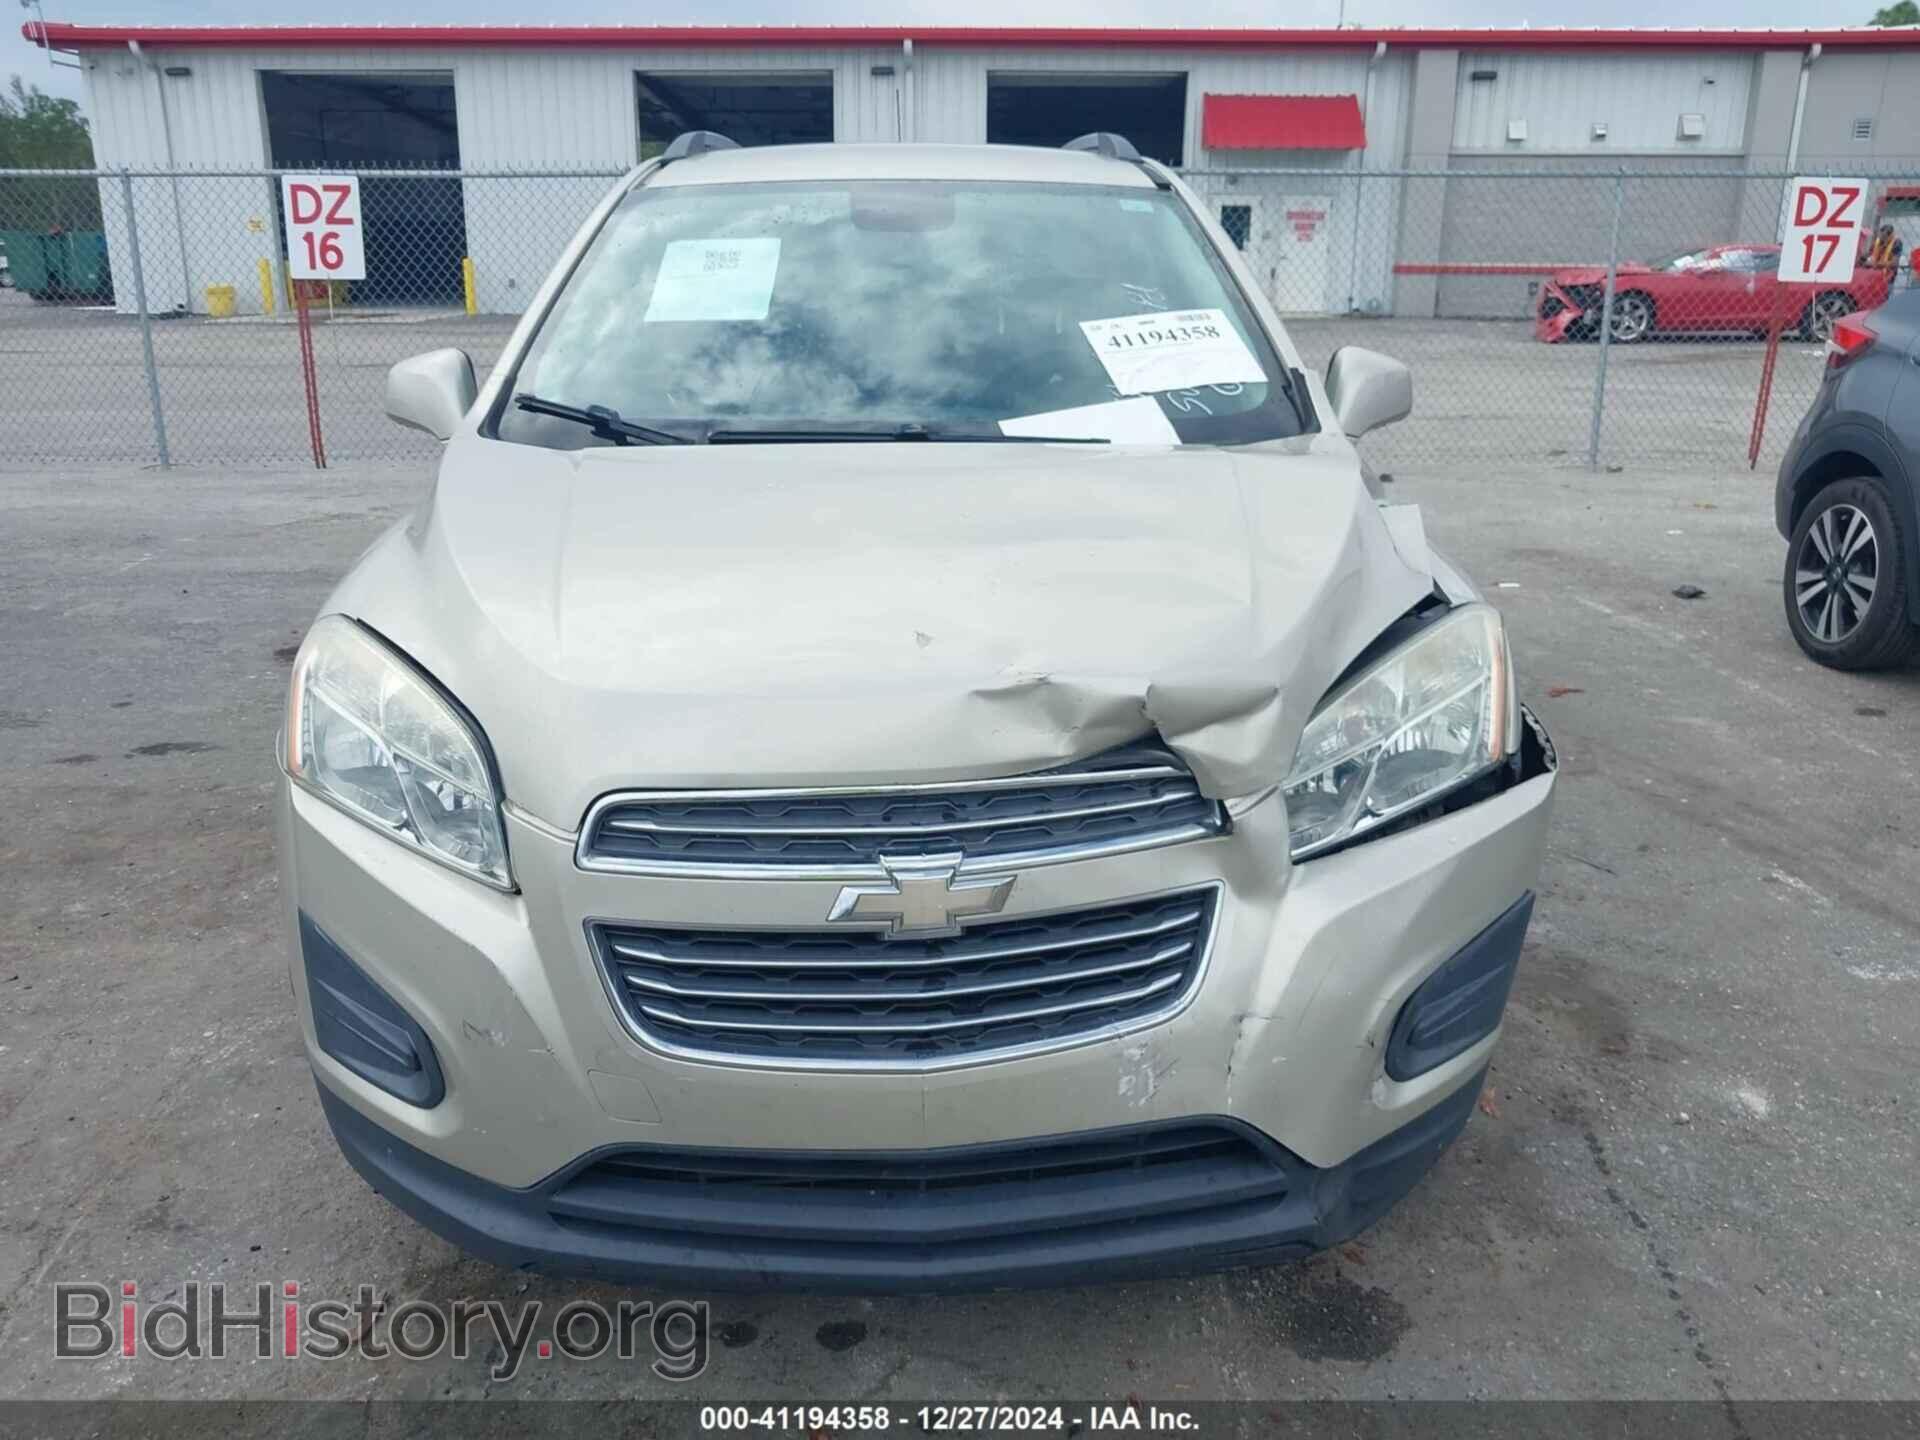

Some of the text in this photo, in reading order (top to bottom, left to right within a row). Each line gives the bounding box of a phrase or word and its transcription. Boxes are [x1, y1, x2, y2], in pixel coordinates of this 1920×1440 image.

[289, 184, 354, 225] DZ
[1793, 186, 1860, 228] DZ
[302, 231, 344, 270] 16
[1802, 234, 1841, 273] 17
[1108, 325, 1220, 348] 41194358
